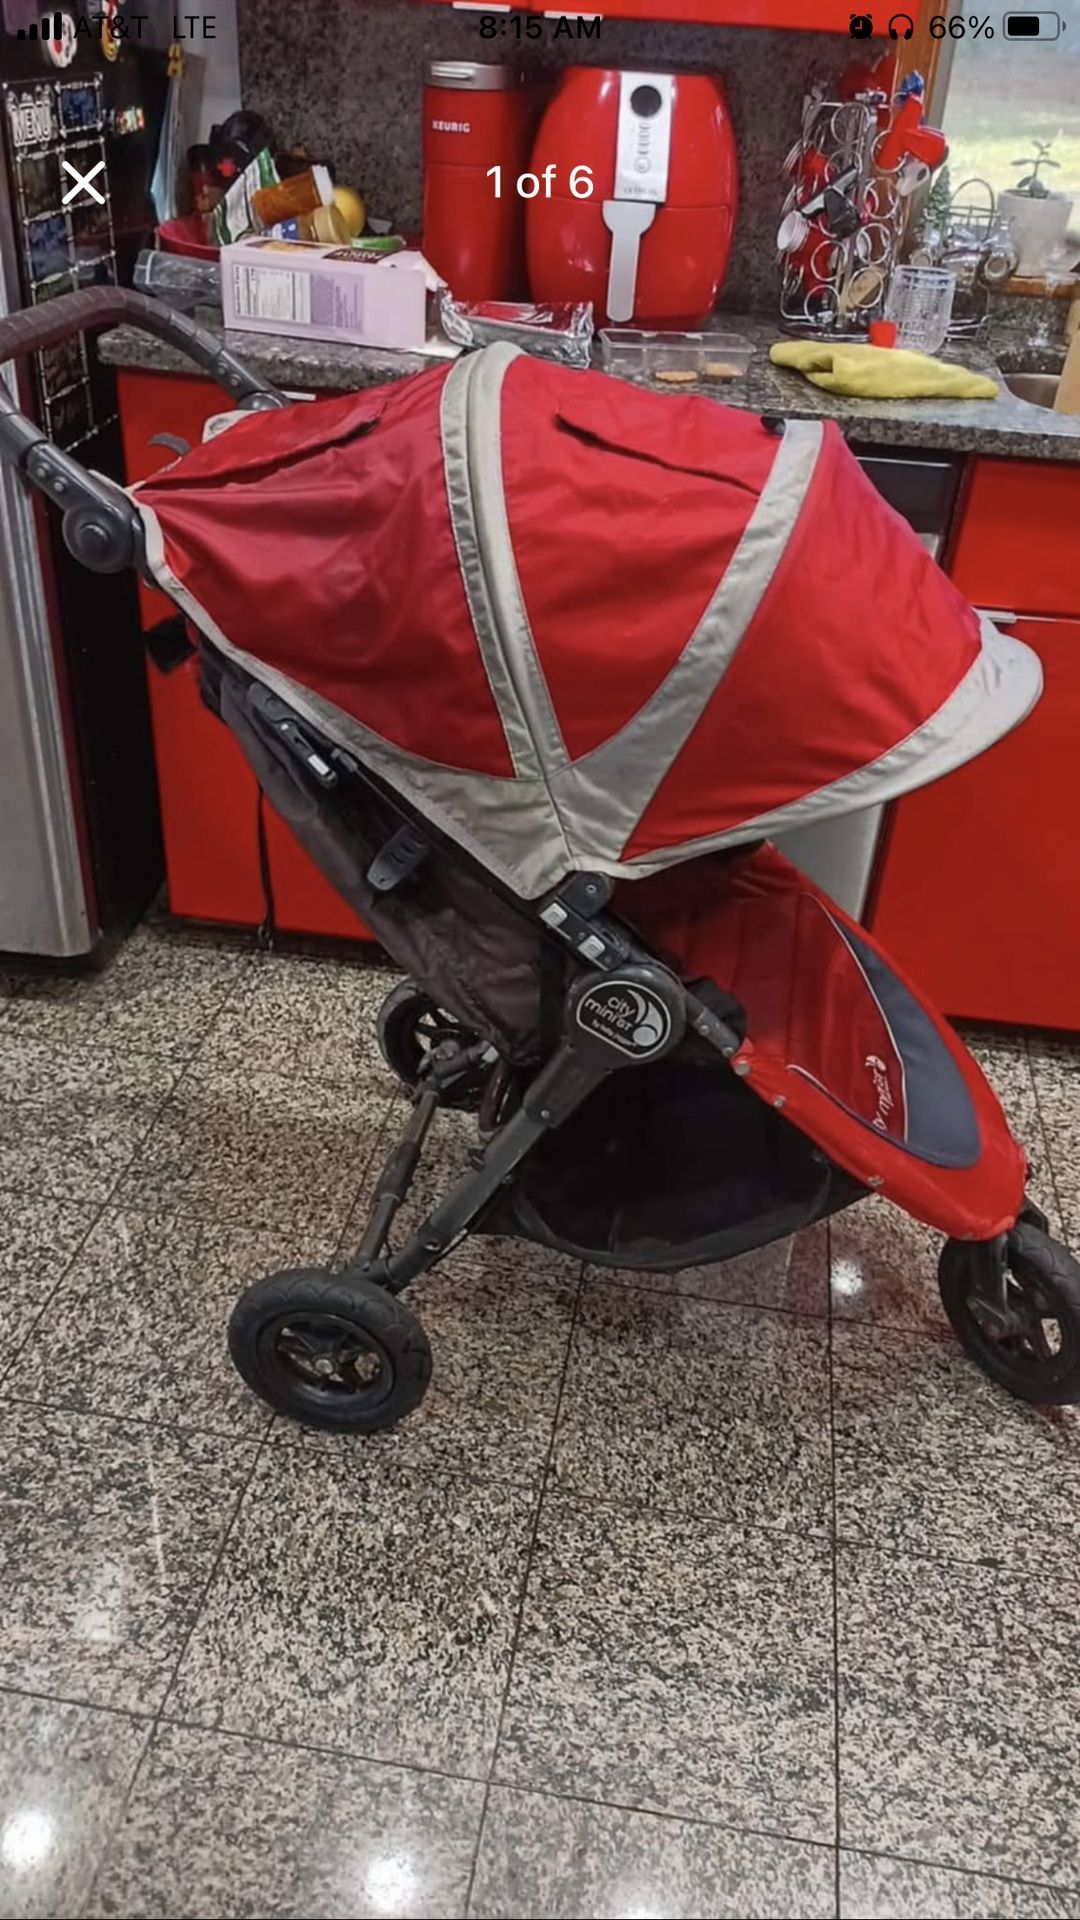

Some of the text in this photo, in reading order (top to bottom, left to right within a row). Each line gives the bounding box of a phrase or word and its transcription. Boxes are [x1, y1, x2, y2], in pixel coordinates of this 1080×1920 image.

[8, 99, 52, 148] MENU
[432, 119, 471, 133] KEURIG
[607, 996, 636, 1018] city
